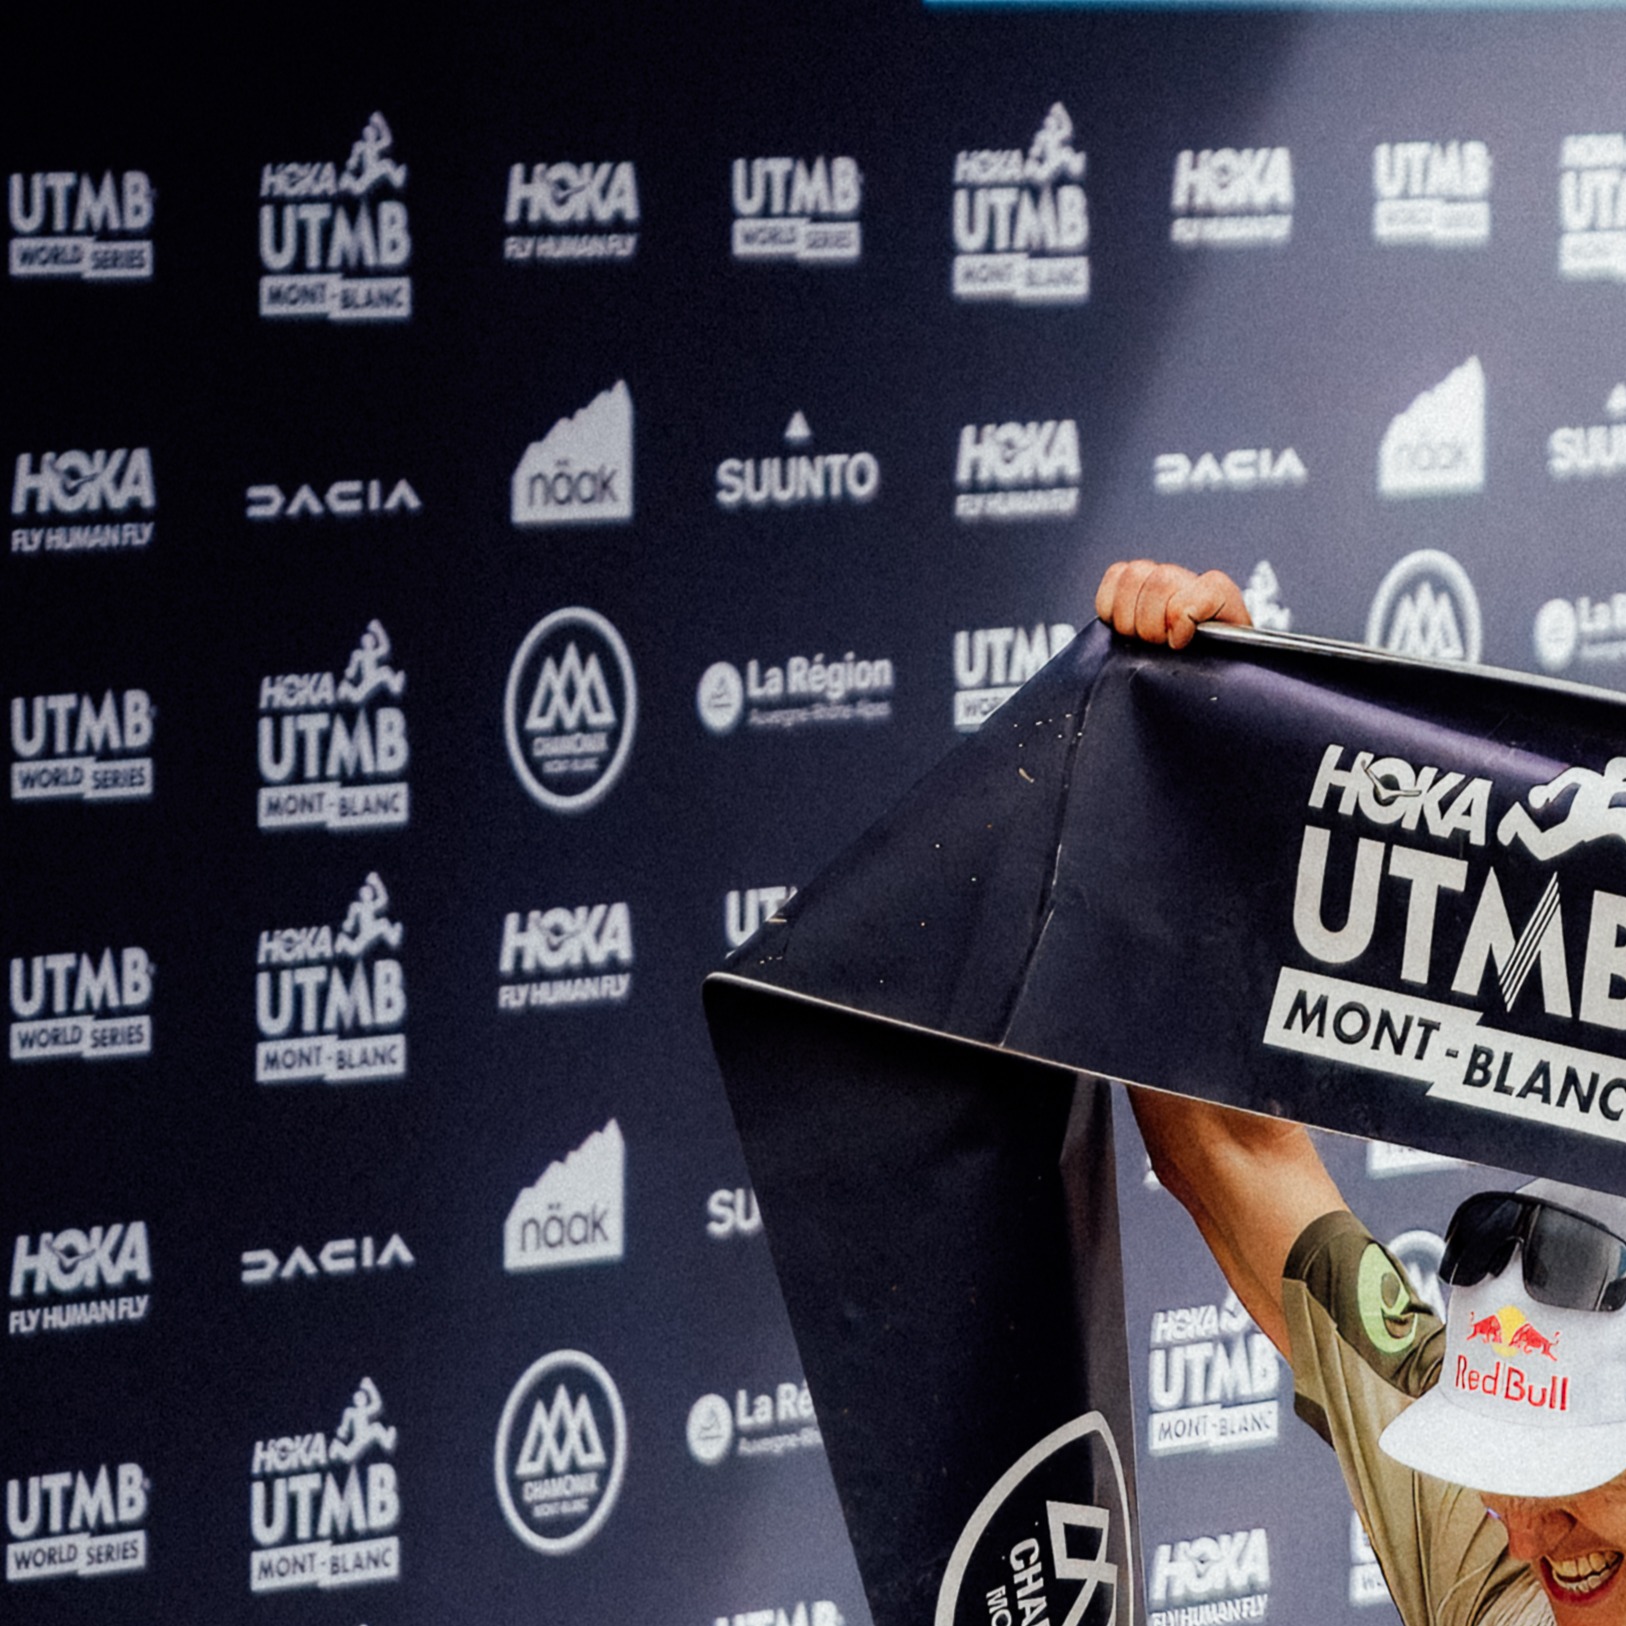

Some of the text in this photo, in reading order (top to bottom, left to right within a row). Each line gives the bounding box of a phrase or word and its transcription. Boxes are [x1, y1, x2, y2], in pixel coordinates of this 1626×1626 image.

[260, 161, 338, 197] HOKA
[504, 161, 640, 223] HOKA
[732, 155, 860, 215] UTMB
[1171, 147, 1293, 210] HOKA
[1372, 140, 1489, 199] UTMB
[9, 170, 153, 232] UTMB
[951, 185, 1089, 251] UTMB
[259, 200, 411, 270] UTMB
[716, 451, 879, 502] SUUNTO
[955, 419, 1081, 482] HOKA
[11, 447, 155, 515] HOKA
[246, 478, 421, 518] DACIA
[526, 459, 618, 506] näak
[258, 671, 335, 709] HOKA
[747, 650, 894, 702] La Région
[10, 689, 153, 757] UTMB
[258, 706, 409, 782] UTMB
[22, 766, 146, 790] WORLD SERIES
[1308, 744, 1493, 847] HOKA
[257, 925, 333, 964] HOKA
[499, 901, 632, 972] HOKA
[9, 946, 152, 1017] UTMB
[256, 958, 406, 1035] UTMB
[18, 1023, 144, 1048] WORLD SERIES
[263, 1044, 398, 1072] MONT-BLANC
[241, 1233, 415, 1283] DACIA
[520, 1204, 608, 1253] näak
[10, 1220, 152, 1297] HOKA
[9, 1294, 150, 1335] FLY HUMAN FLY
[1151, 1305, 1219, 1345] HOKA
[1147, 1331, 1280, 1411] UTMB
[1456, 1355, 1568, 1411] Red Bull
[252, 1432, 327, 1474] HOKA
[6, 1463, 147, 1539] UTMB
[251, 1462, 400, 1546] UTMB
[13, 1540, 139, 1571] WORLD SERIES
[257, 1547, 392, 1581] MONT-BLANC
[1148, 1528, 1271, 1600] HOKA
